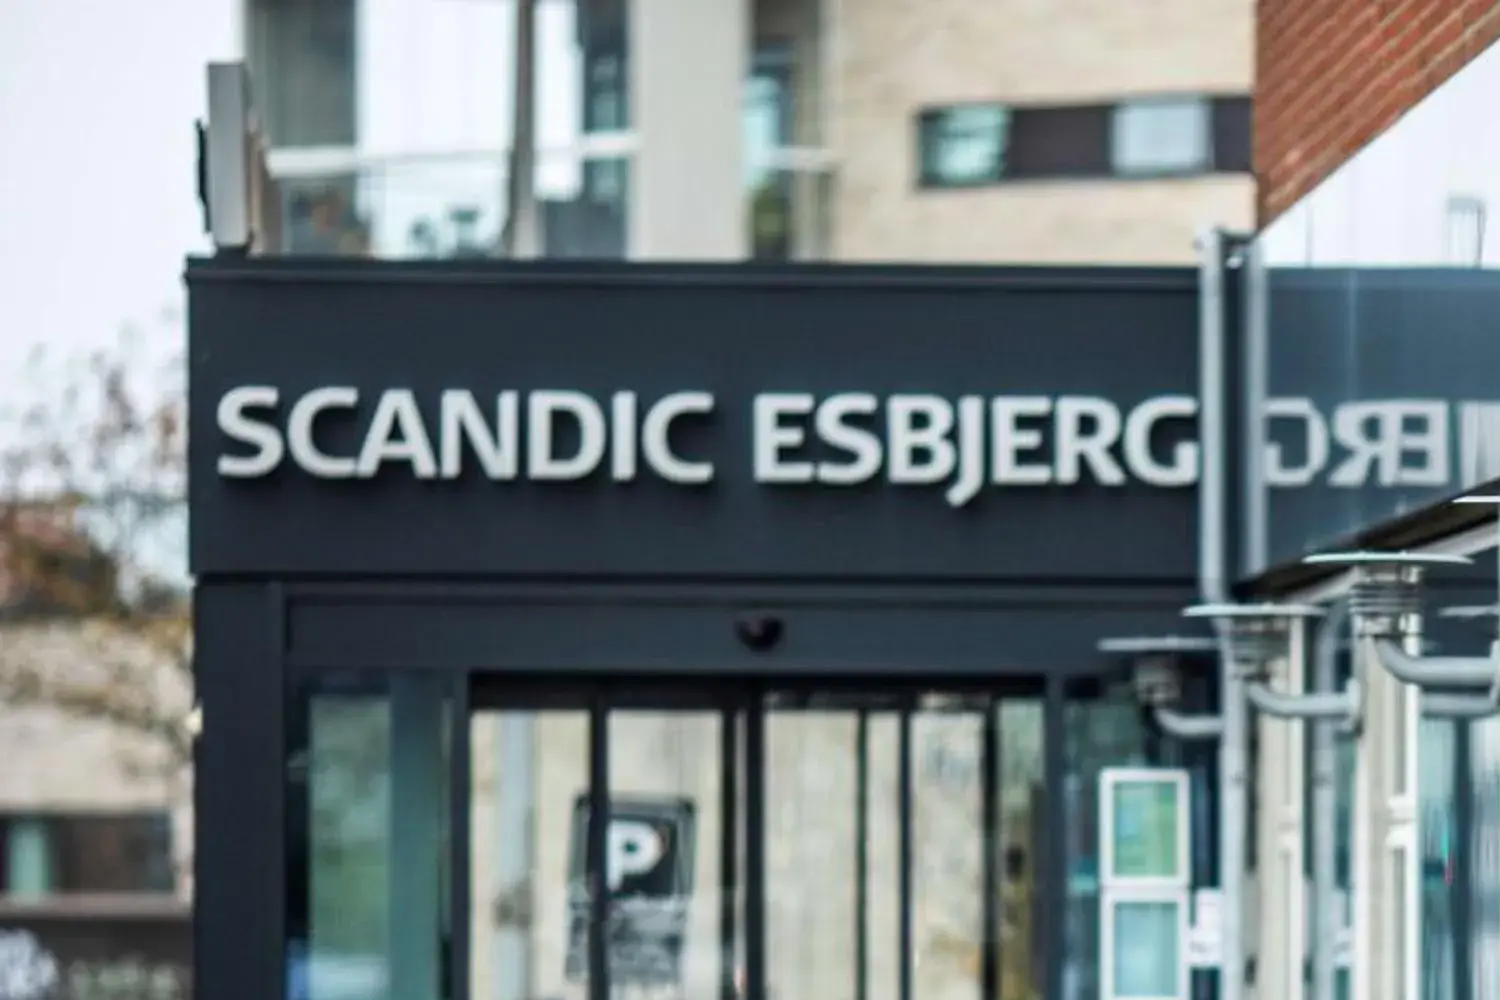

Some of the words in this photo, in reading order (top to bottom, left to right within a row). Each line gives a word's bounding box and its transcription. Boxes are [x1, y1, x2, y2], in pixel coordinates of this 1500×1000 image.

[216, 385, 715, 483] SCANDIC
[752, 392, 1200, 507] ESBJERG
[606, 819, 662, 892] P
